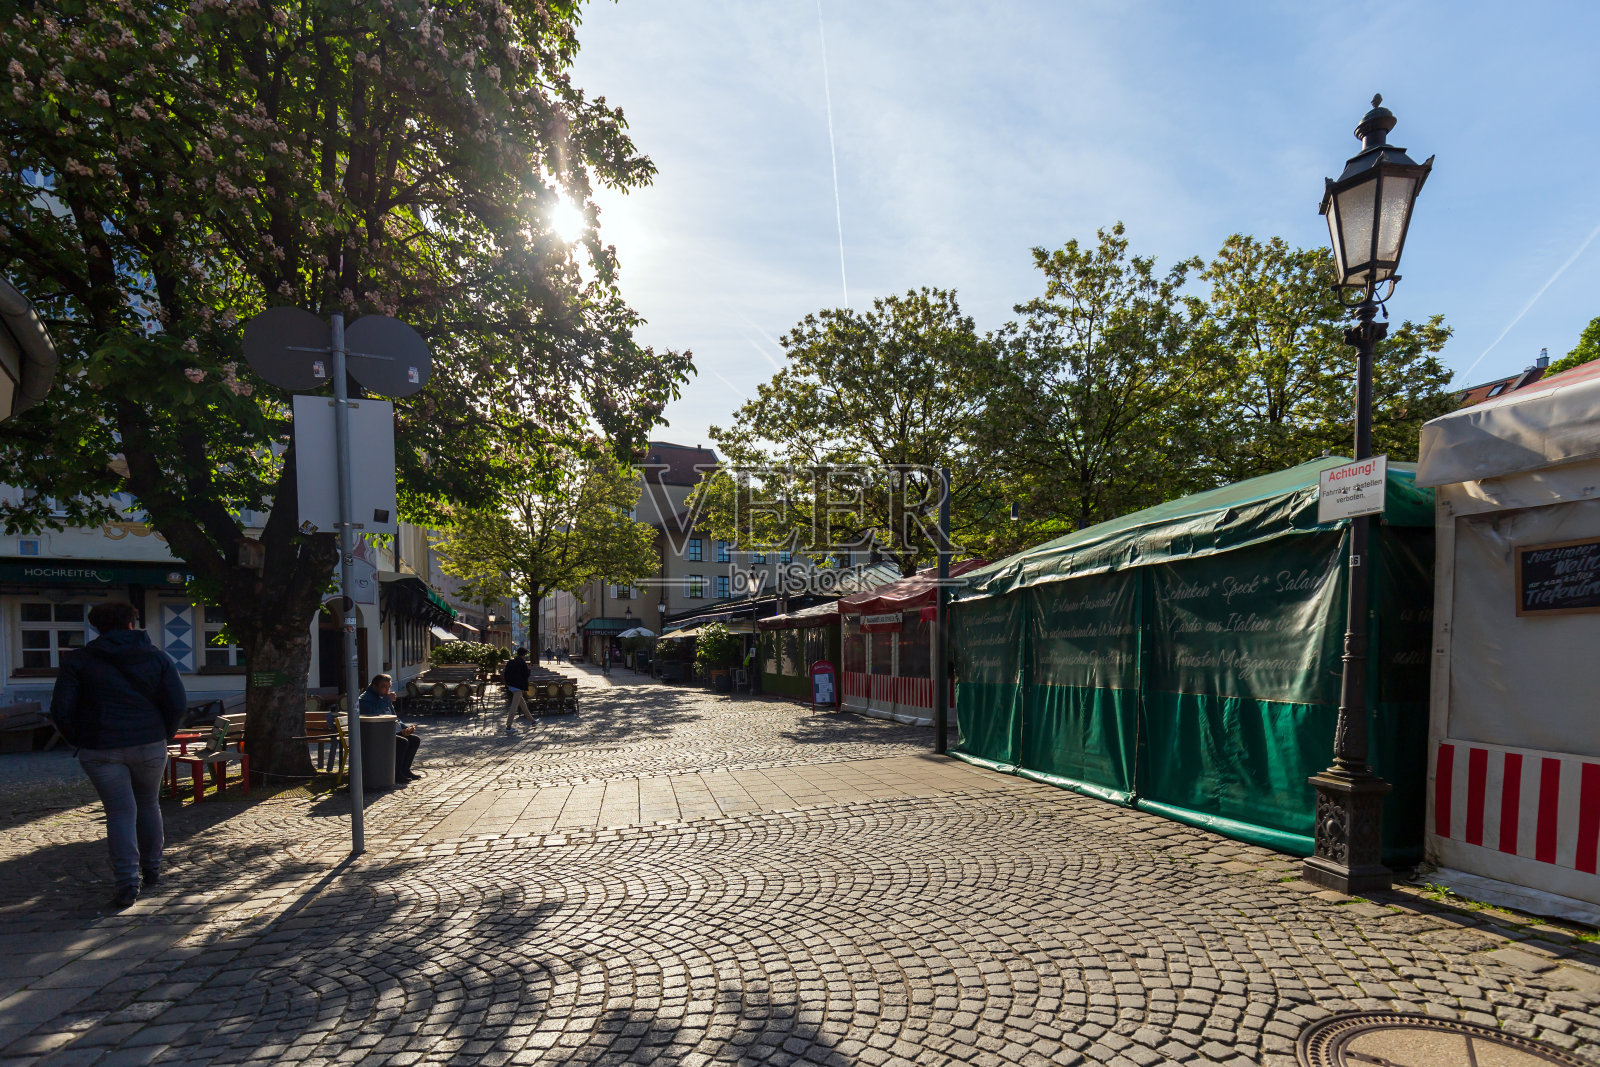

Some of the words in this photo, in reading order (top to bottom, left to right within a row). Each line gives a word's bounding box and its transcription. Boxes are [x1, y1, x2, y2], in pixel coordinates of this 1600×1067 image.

[1328, 460, 1376, 483] Achtung!
[1352, 479, 1383, 491] abstellen
[1336, 493, 1366, 504] verboten.
[25, 568, 108, 582] HOCHREITER
[1221, 575, 1260, 605] Speck
[1204, 621, 1222, 633] aus
[1222, 612, 1271, 633] Italien
